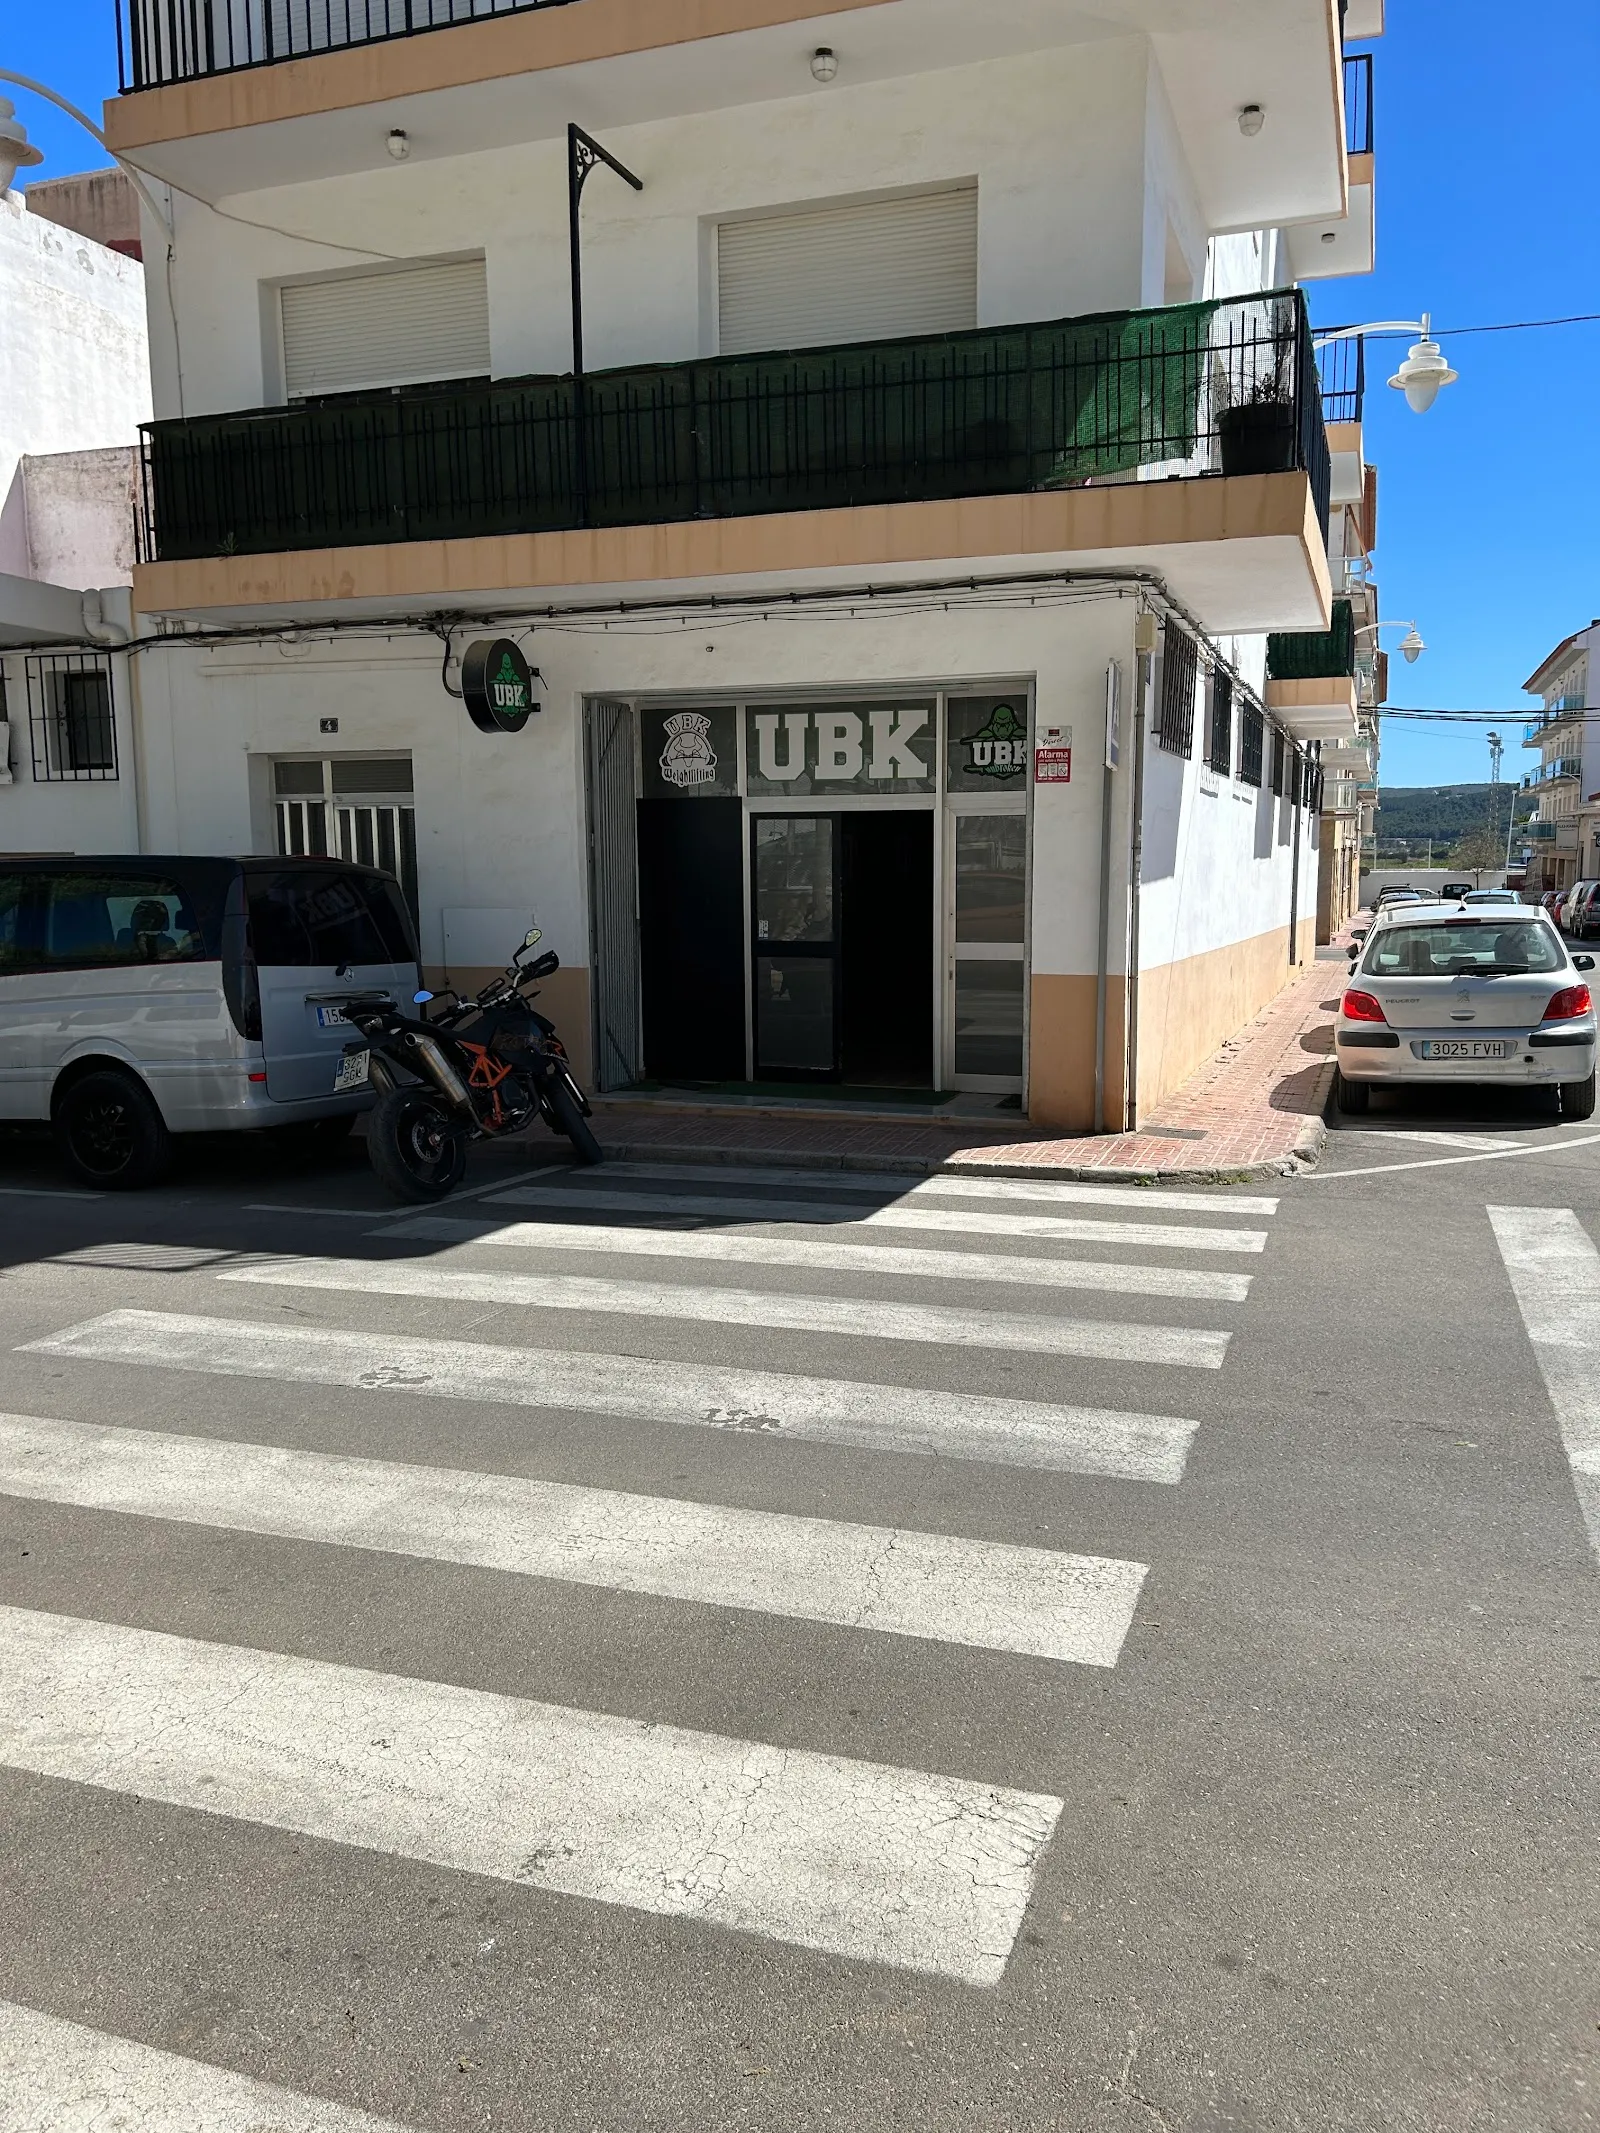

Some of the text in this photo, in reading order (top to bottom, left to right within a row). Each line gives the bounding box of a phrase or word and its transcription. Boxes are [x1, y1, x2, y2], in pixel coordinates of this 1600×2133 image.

[494, 684, 525, 707] UBK
[325, 720, 332, 731] 4
[666, 714, 710, 736] UBK
[755, 709, 929, 781] UBK
[972, 740, 1027, 766] UBK
[1038, 750, 1069, 759] Alarma
[1433, 1043, 1501, 1056] 3025 FVH
